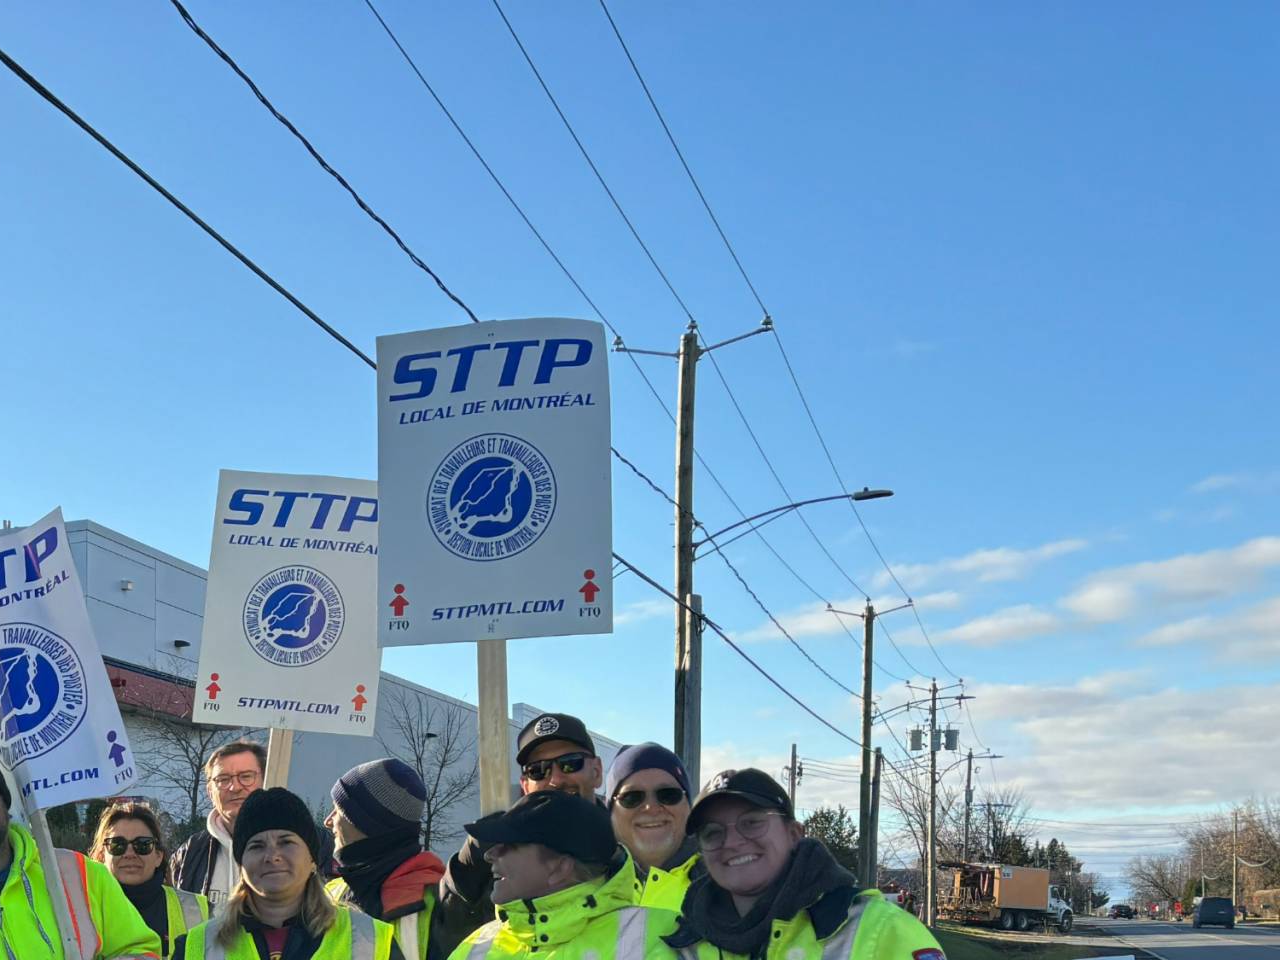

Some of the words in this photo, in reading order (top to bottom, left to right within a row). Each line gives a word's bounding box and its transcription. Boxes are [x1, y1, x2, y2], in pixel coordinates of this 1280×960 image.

[390, 338, 593, 402] STTP
[399, 407, 456, 424] LOCAL
[461, 401, 487, 415] DE
[492, 392, 596, 412] MONTRÉAL
[223, 489, 378, 532] STTP
[229, 534, 274, 547] LOCAL
[280, 537, 299, 548] DE
[432, 599, 565, 621] STTPMTL.COM
[579, 607, 601, 618] FTQ
[388, 620, 410, 631] FTQ
[237, 697, 340, 715] STTPMTL.COM
[22, 768, 99, 797] MTL.COM
